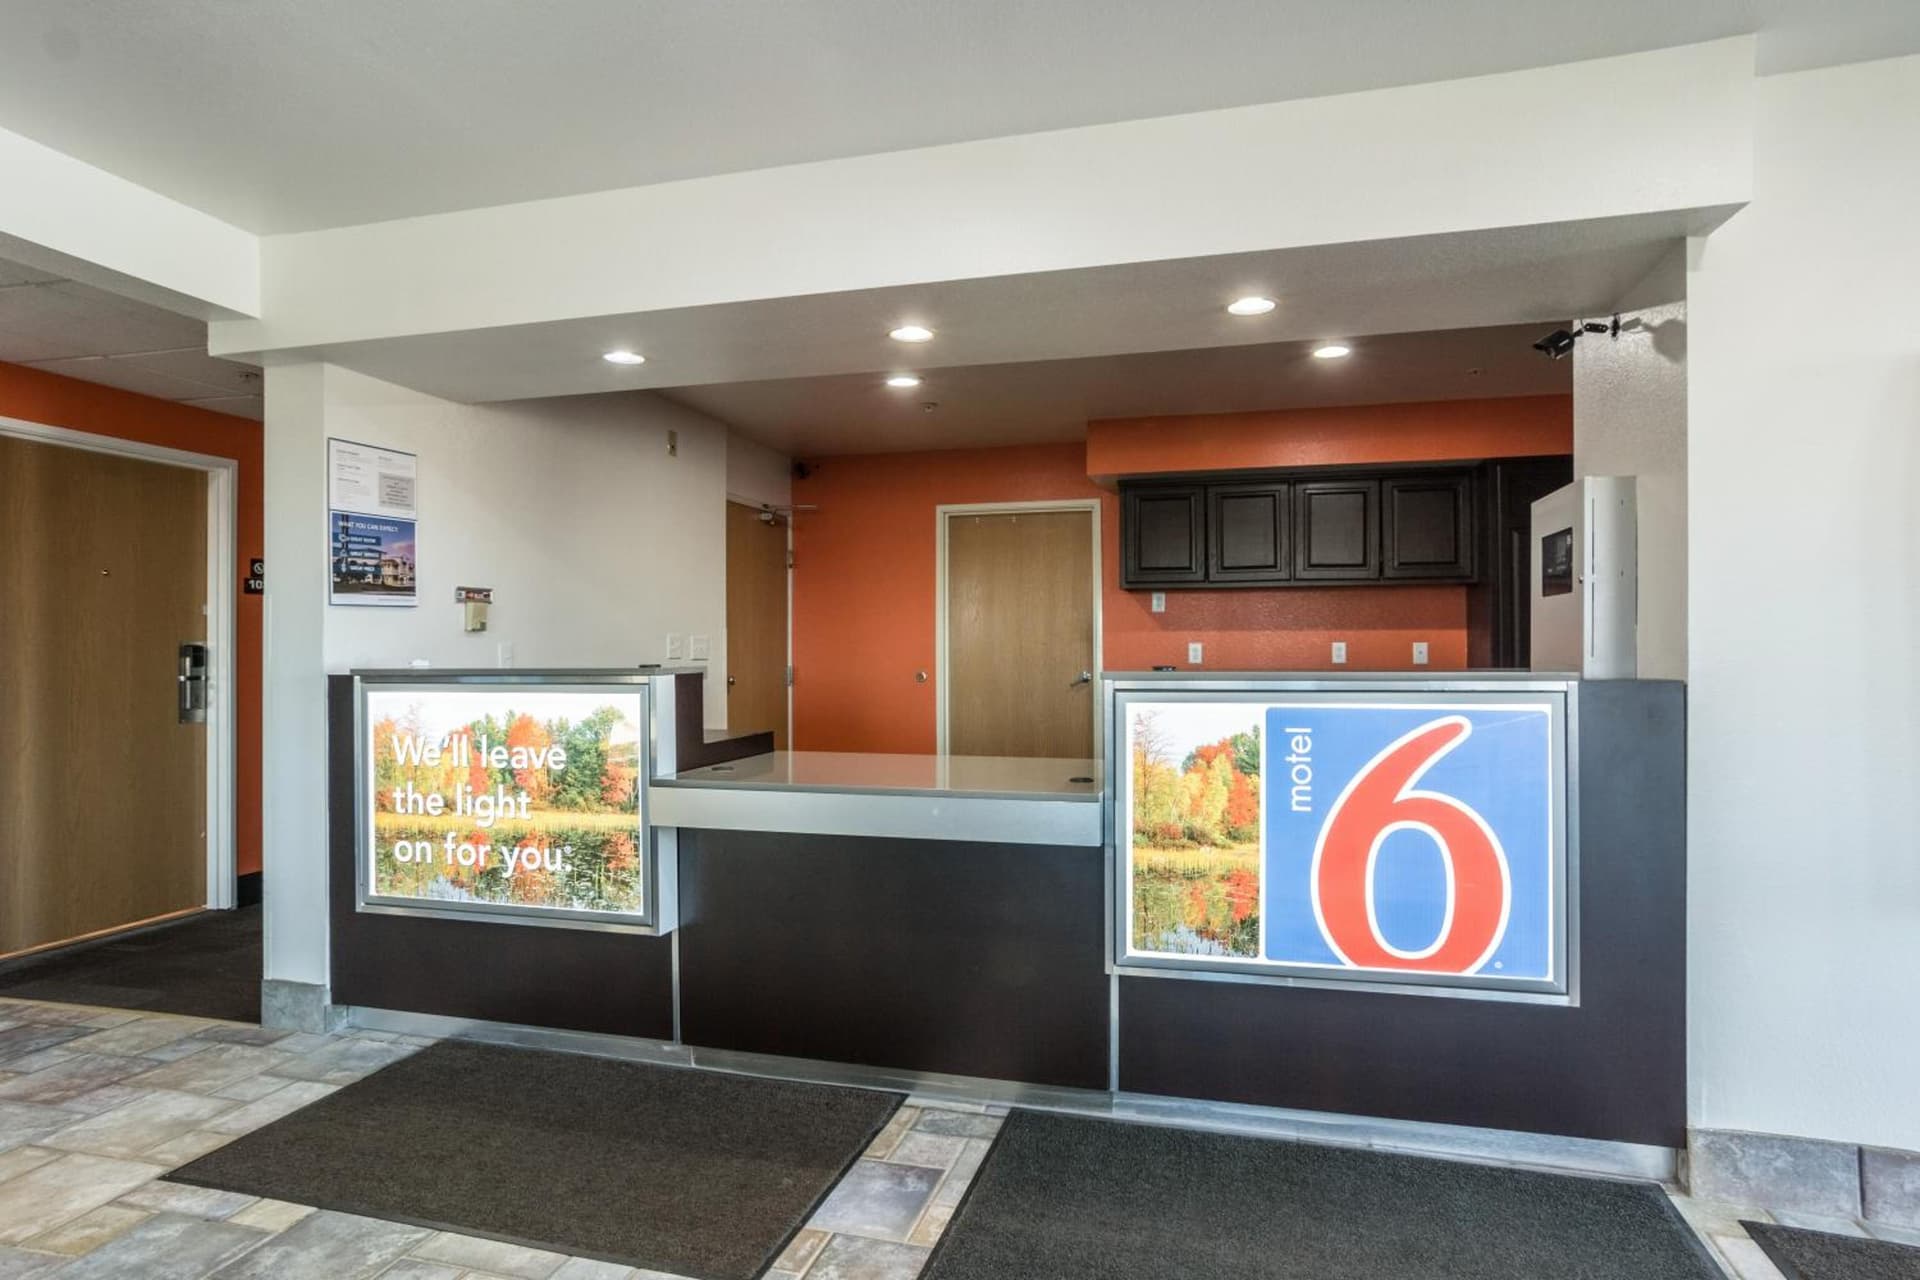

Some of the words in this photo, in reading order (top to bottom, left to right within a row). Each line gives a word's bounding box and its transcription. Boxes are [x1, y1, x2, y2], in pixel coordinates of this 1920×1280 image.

[392, 734, 470, 768] We'll
[481, 735, 567, 770] leave
[1285, 726, 1312, 812] motel
[392, 782, 445, 816] the
[456, 783, 533, 827] light
[394, 839, 432, 864] on
[444, 832, 491, 866] for
[1311, 715, 1512, 976] 6
